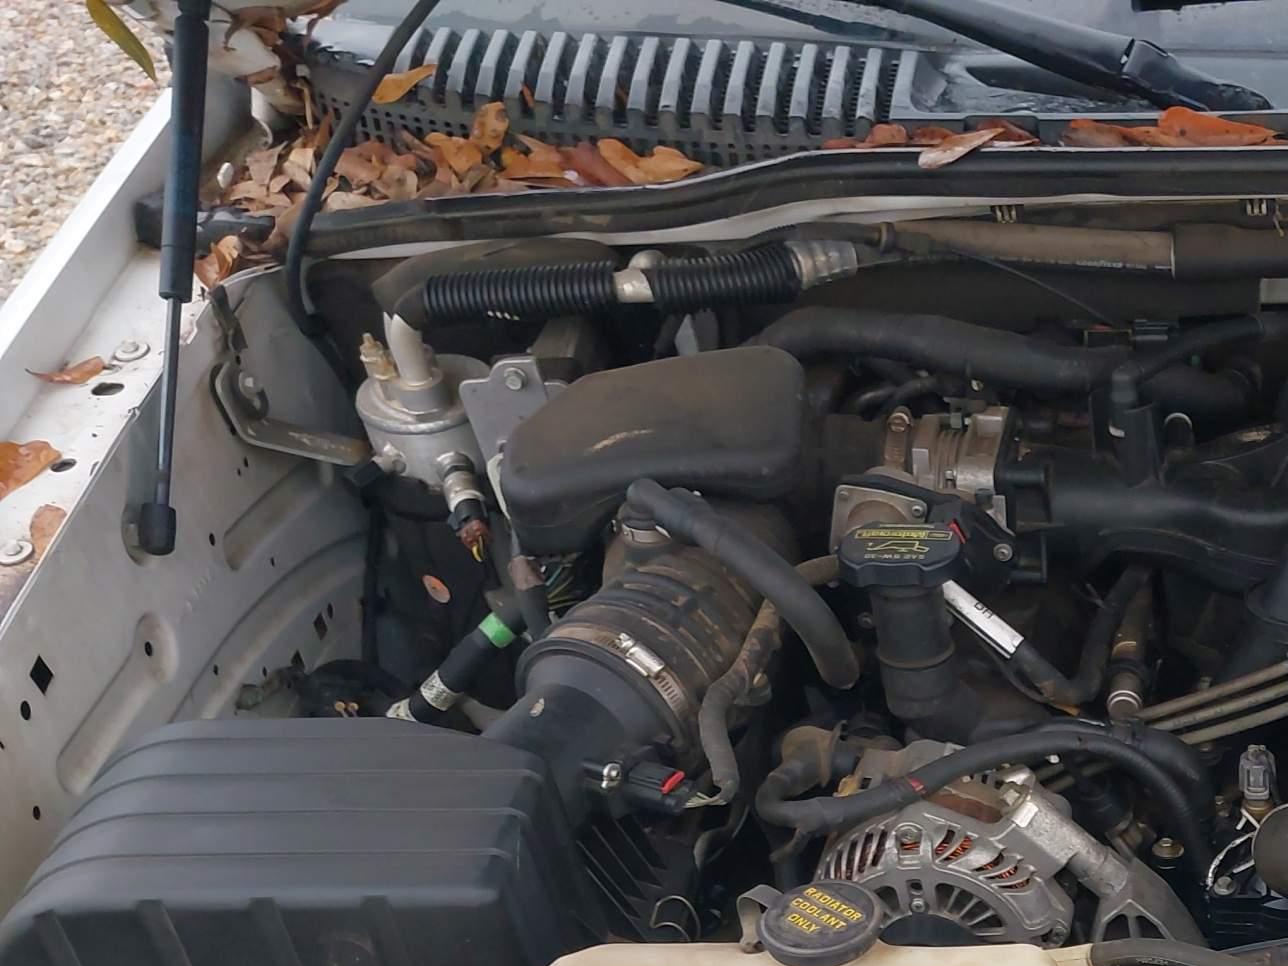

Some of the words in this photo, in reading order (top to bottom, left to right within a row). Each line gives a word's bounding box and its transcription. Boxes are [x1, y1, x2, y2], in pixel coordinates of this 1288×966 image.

[791, 897, 848, 929] COOLANT
[804, 887, 863, 921] RADIATOR
[787, 913, 820, 933] ONLY
